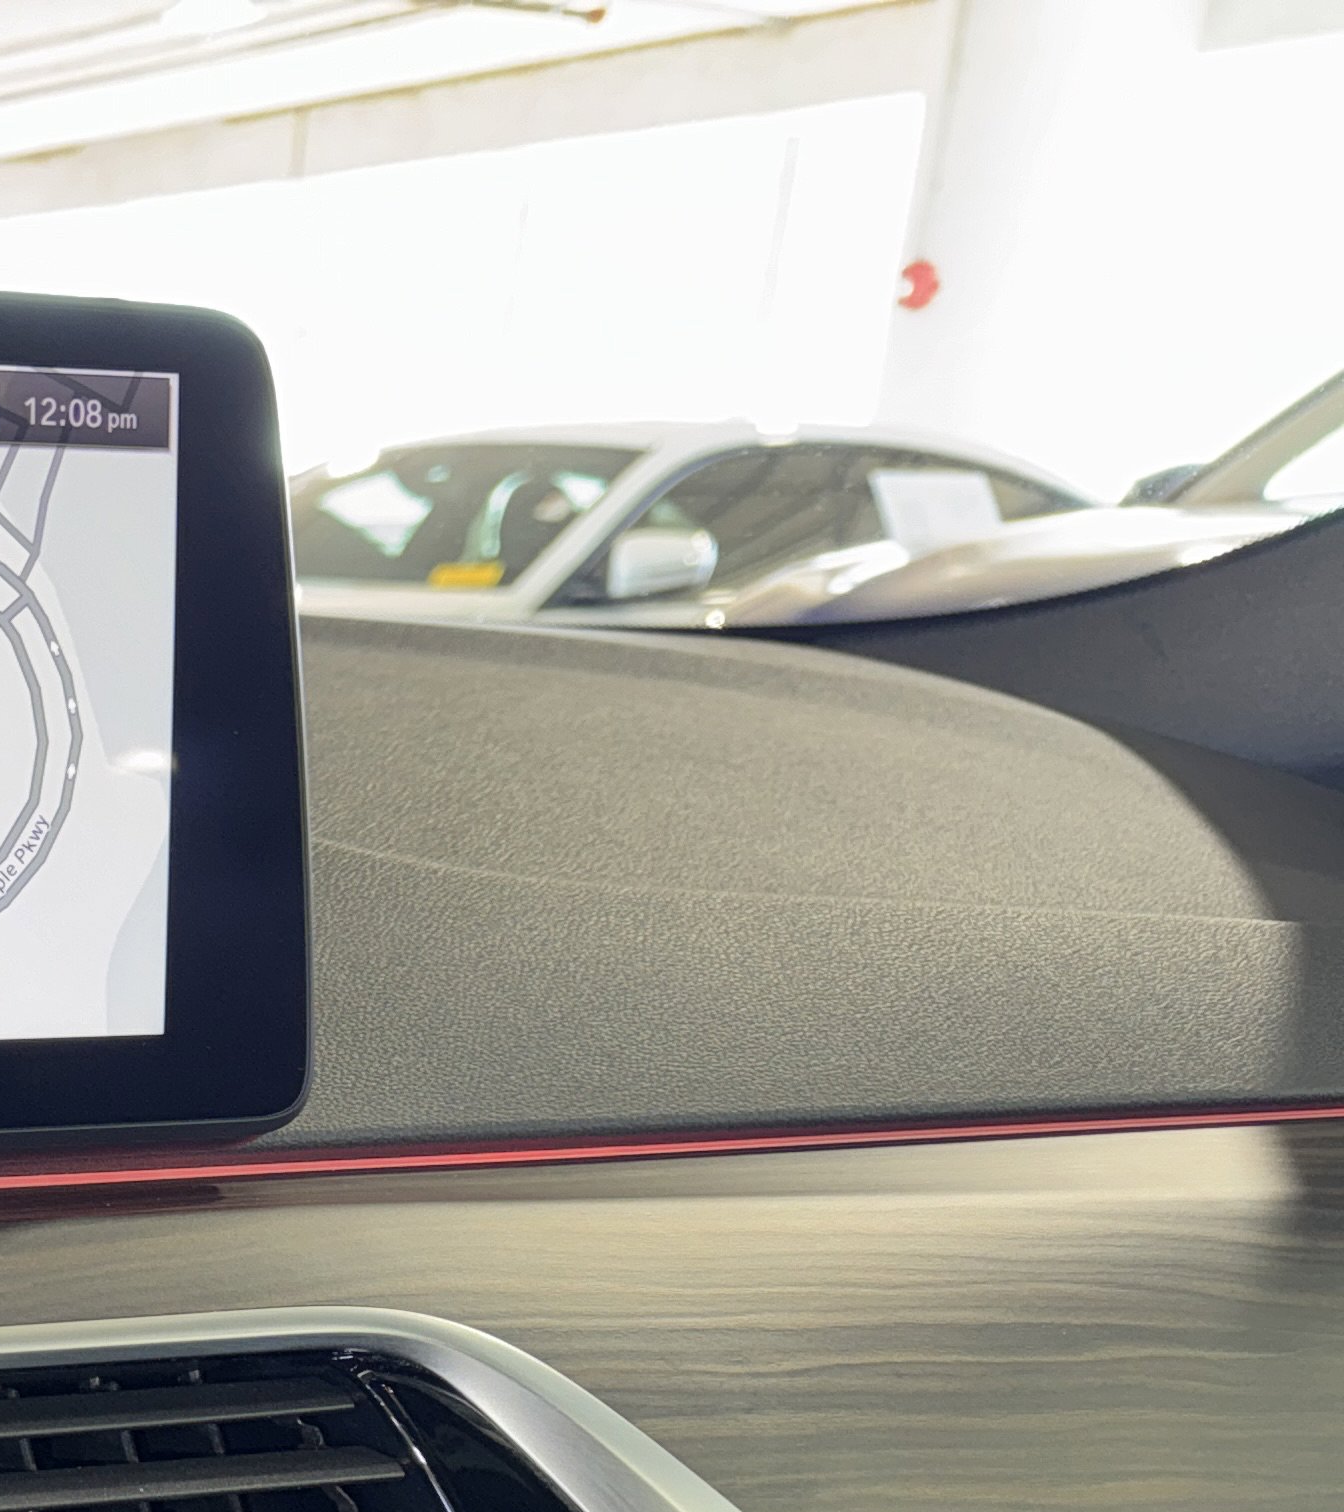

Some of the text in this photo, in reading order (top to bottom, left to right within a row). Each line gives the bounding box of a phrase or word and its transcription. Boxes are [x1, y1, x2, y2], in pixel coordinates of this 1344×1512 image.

[23, 397, 138, 432] 12:08 pm
[14, 814, 50, 864] Pkwy
